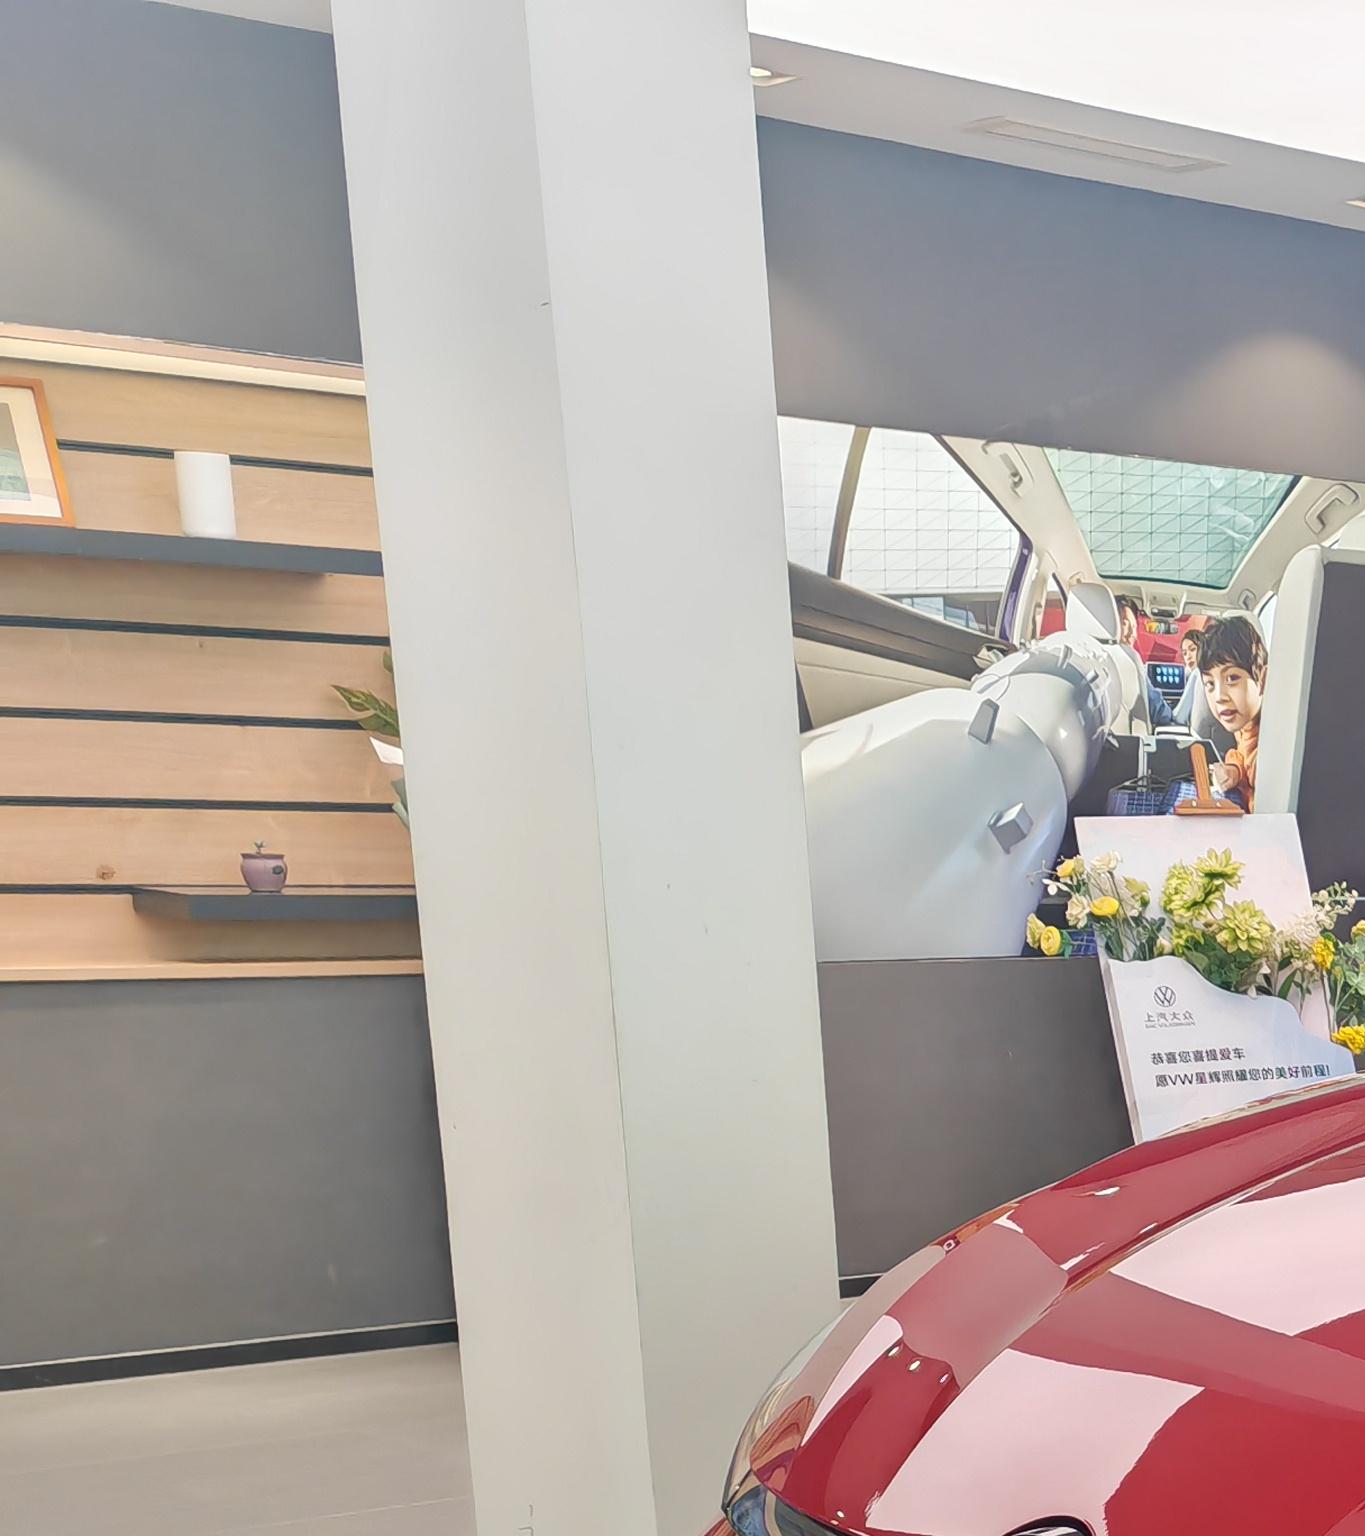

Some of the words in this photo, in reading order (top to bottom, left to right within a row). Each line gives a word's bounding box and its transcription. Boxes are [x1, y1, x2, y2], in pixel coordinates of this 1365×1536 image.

[1150, 1047, 1246, 1066] 恭喜您喜提爱车
